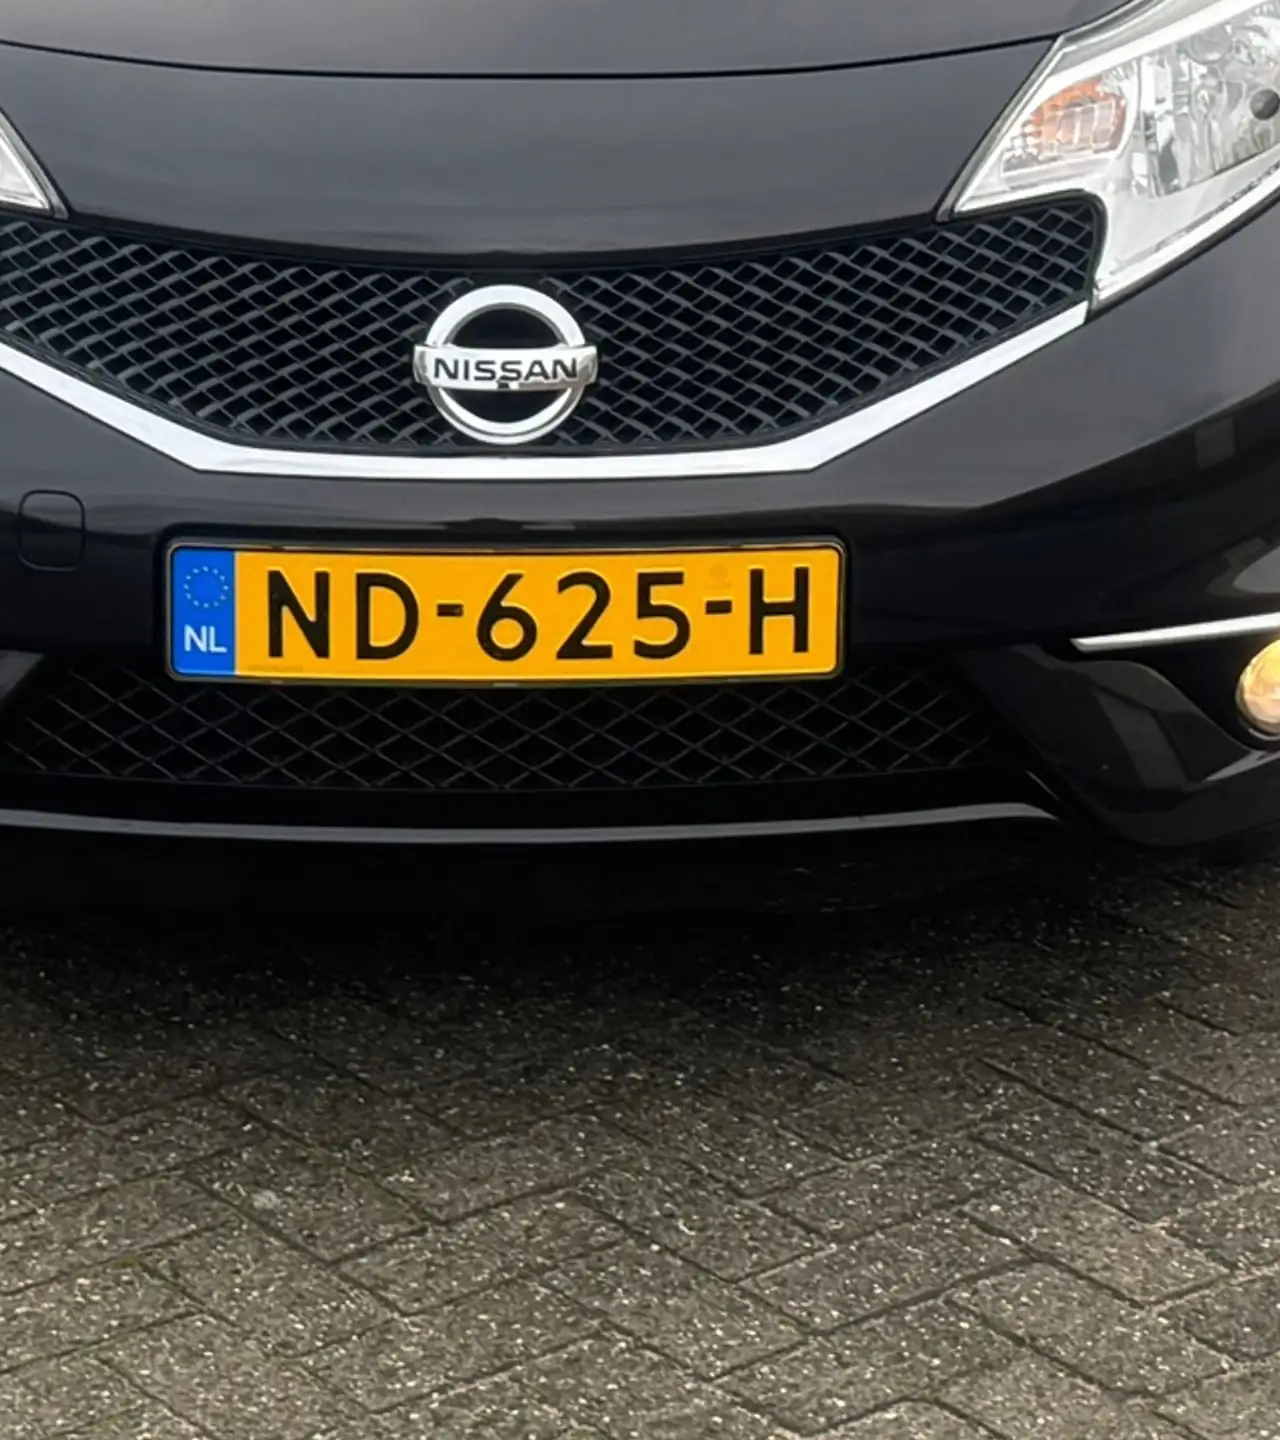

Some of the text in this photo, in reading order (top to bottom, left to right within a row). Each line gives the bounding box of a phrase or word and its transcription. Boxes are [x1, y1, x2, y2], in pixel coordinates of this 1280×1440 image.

[433, 357, 577, 381] NISSAN
[266, 566, 811, 662] ND-625-H
[184, 624, 227, 653] NL
